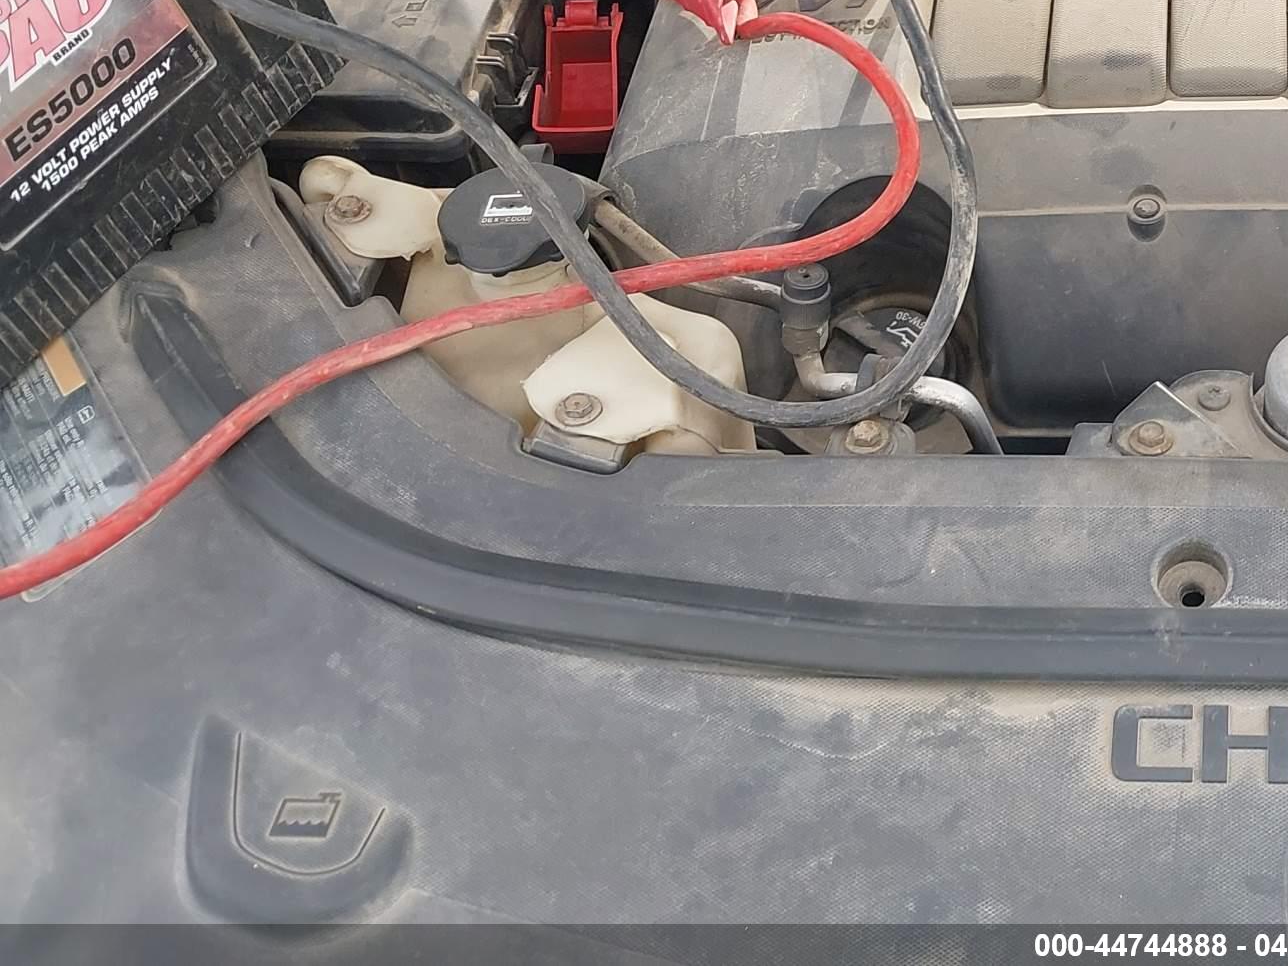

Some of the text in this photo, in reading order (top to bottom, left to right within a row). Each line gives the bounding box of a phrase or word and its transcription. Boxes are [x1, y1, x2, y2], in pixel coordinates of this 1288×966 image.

[4, 38, 136, 162] ES5000
[53, 29, 90, 62] BRAND
[10, 181, 31, 202] 12
[32, 148, 66, 184] VOLT
[69, 104, 120, 153] POWER
[121, 56, 172, 107] SUPPLY
[42, 86, 159, 191] 1500 PEAK AMPS
